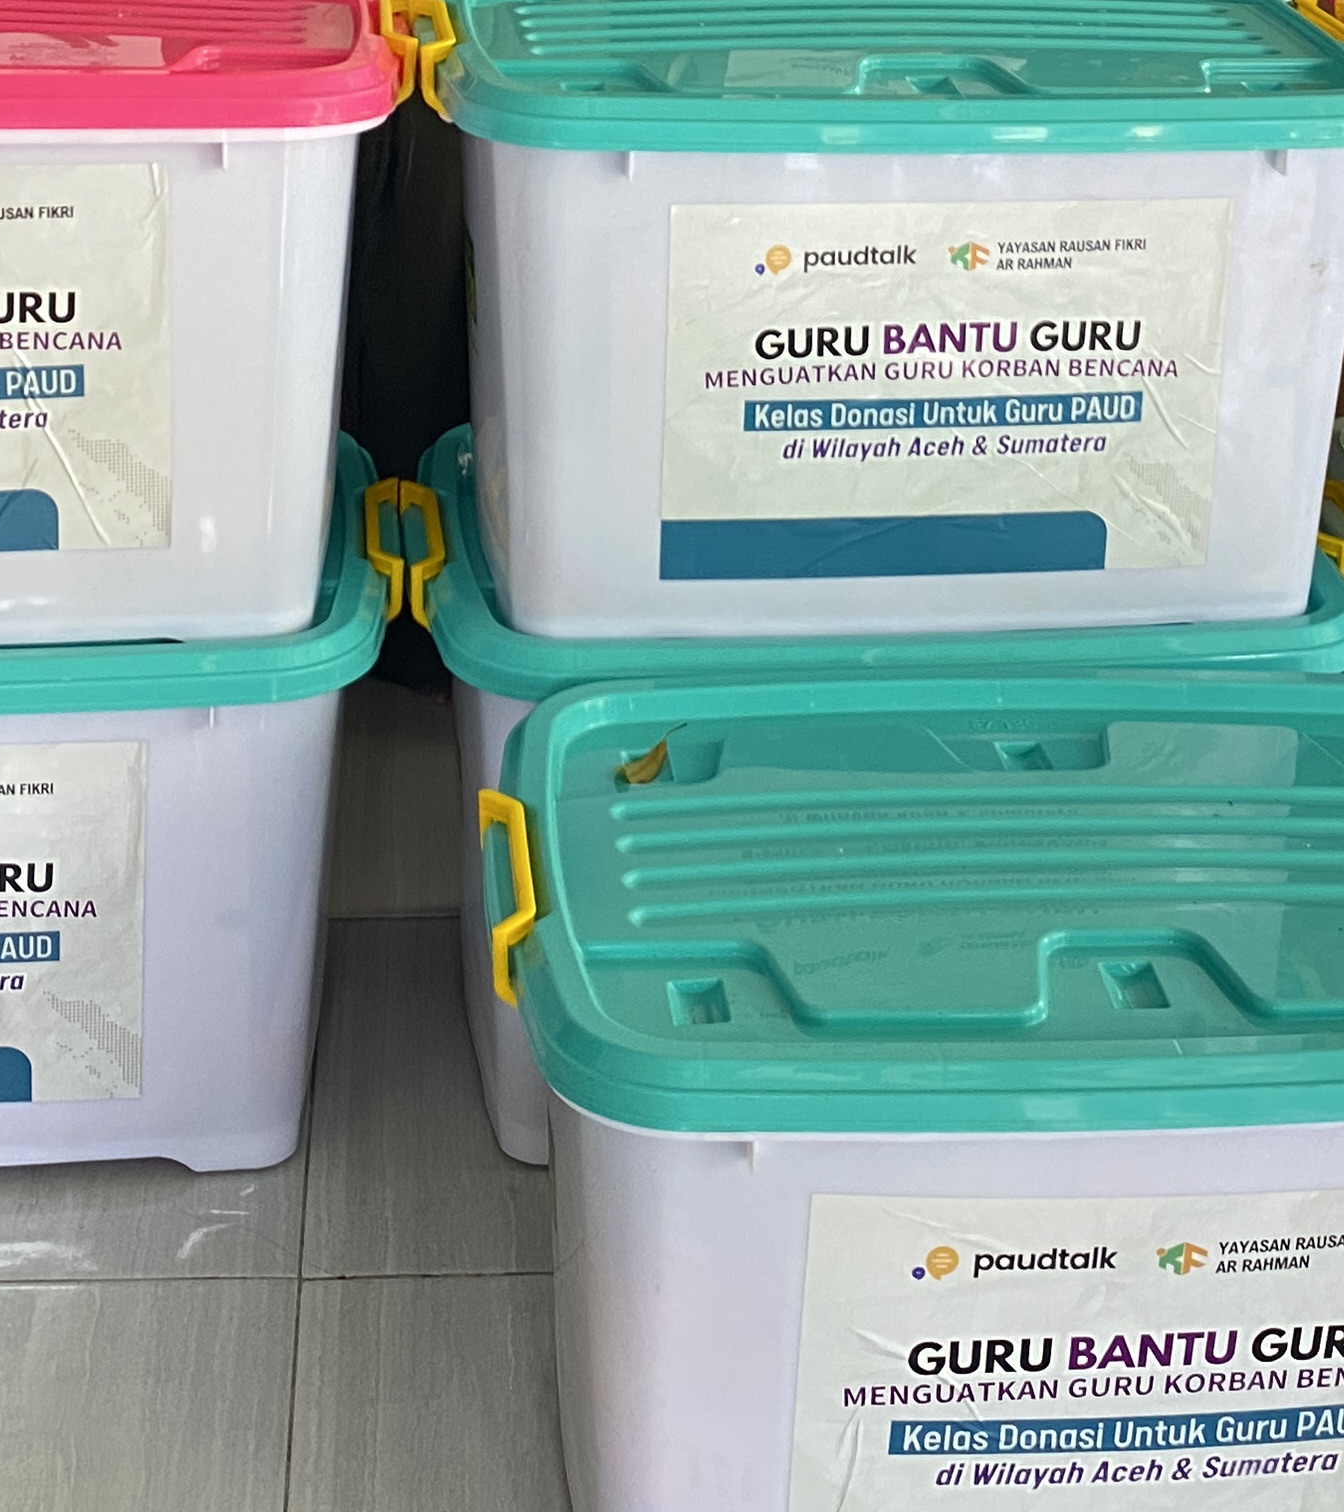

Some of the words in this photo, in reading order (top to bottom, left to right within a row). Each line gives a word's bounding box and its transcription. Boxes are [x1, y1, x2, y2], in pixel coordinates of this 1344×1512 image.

[38, 206, 74, 219] FIKRI
[803, 246, 916, 272] paudtalk
[0, 332, 122, 350] BENCANA
[756, 326, 870, 360] GURU
[883, 323, 1018, 355] BANTU
[1030, 321, 1142, 352] GURU
[6, 370, 76, 396] PAUD
[1219, 1237, 1291, 1255] YAYASAN
[973, 1247, 1117, 1278] paudtalk
[1215, 1259, 1237, 1273] AR
[1242, 1255, 1310, 1272] RAHMAN
[907, 1337, 1052, 1376] GURU
[1068, 1330, 1239, 1371] BANTU
[843, 1379, 1058, 1408] MENGUATKAN
[1068, 1374, 1154, 1399] GURU
[1163, 1370, 1286, 1395] KORBAN
[903, 1422, 988, 1451] Kelas
[998, 1422, 1104, 1450] Donasi
[1114, 1417, 1205, 1447] Untuk
[1215, 1413, 1287, 1442] Guru
[936, 1464, 963, 1486] di
[972, 1460, 1083, 1489] Wilayah
[1091, 1459, 1162, 1482] Aceh
[1171, 1458, 1193, 1479] &
[1202, 1450, 1338, 1476] Sumatera
